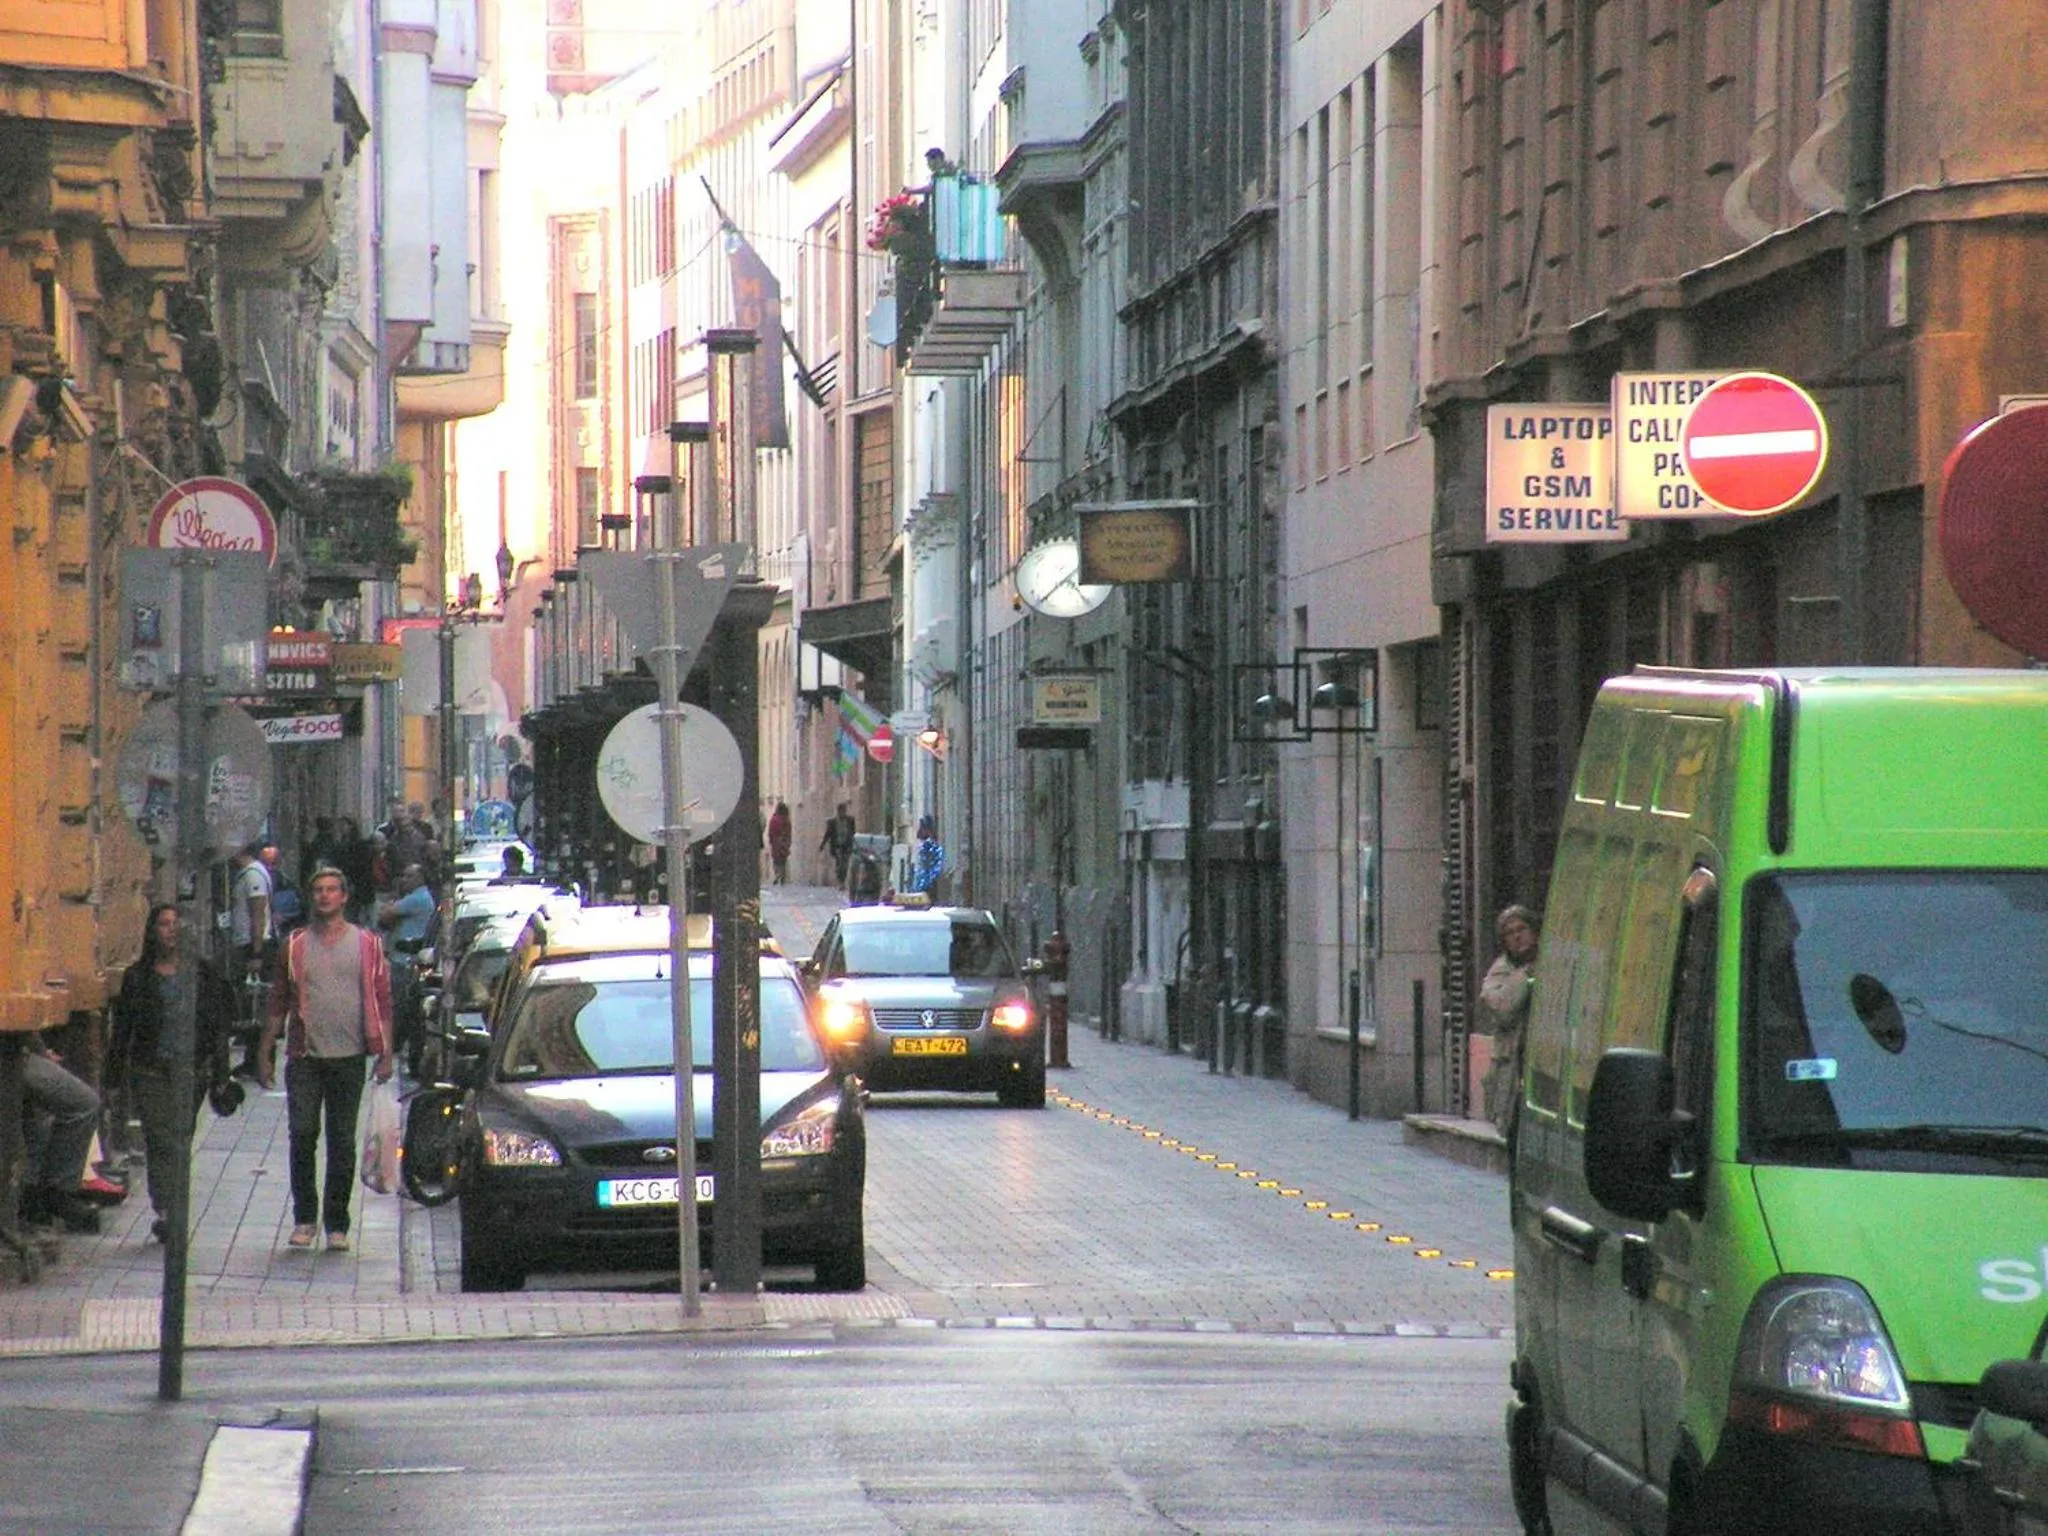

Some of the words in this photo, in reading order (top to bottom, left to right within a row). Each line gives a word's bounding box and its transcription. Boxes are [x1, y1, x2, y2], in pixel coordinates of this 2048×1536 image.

[1629, 380, 1717, 406] INTER
[1504, 417, 1612, 440] LAPTOP
[1551, 446, 1566, 469] &
[1524, 475, 1592, 498] GSM
[1499, 508, 1619, 531] SERVICE
